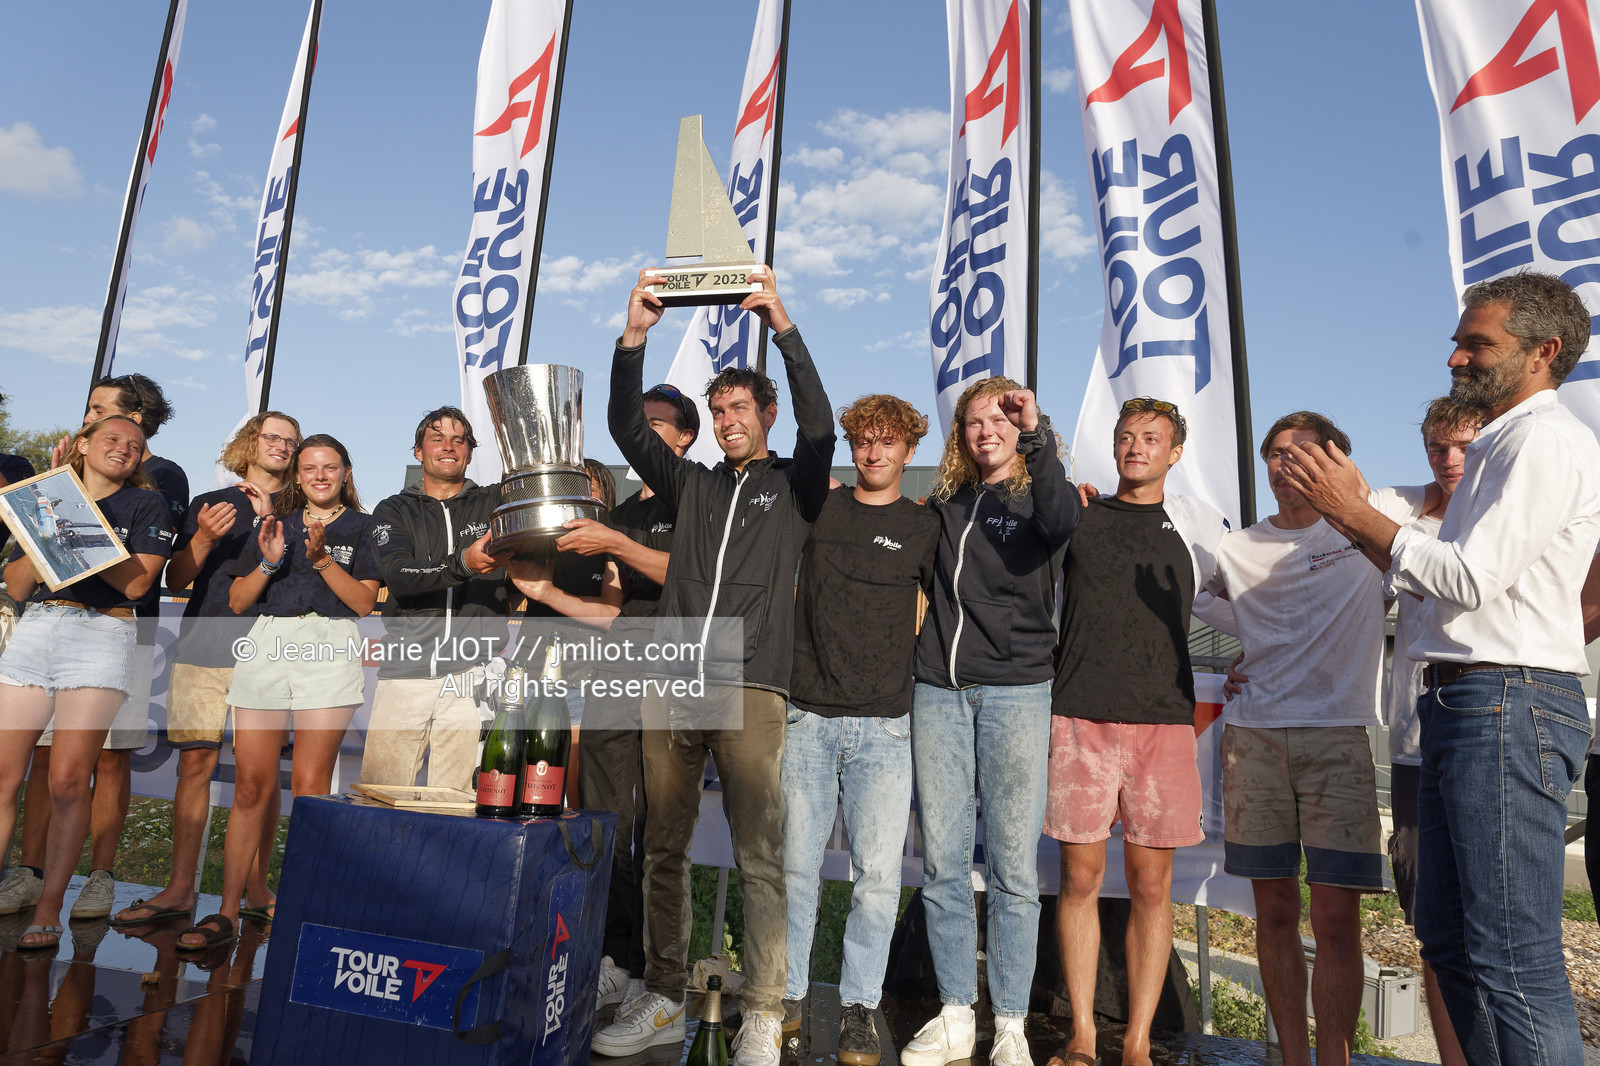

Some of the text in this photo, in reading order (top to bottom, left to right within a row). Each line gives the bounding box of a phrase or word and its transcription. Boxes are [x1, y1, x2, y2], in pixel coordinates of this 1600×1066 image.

[713, 273, 747, 286] 2023
[330, 946, 399, 979] TOUR
[334, 969, 402, 1001] VOILE
[552, 952, 569, 1030] VOILE
[542, 963, 560, 1047] TOUR
